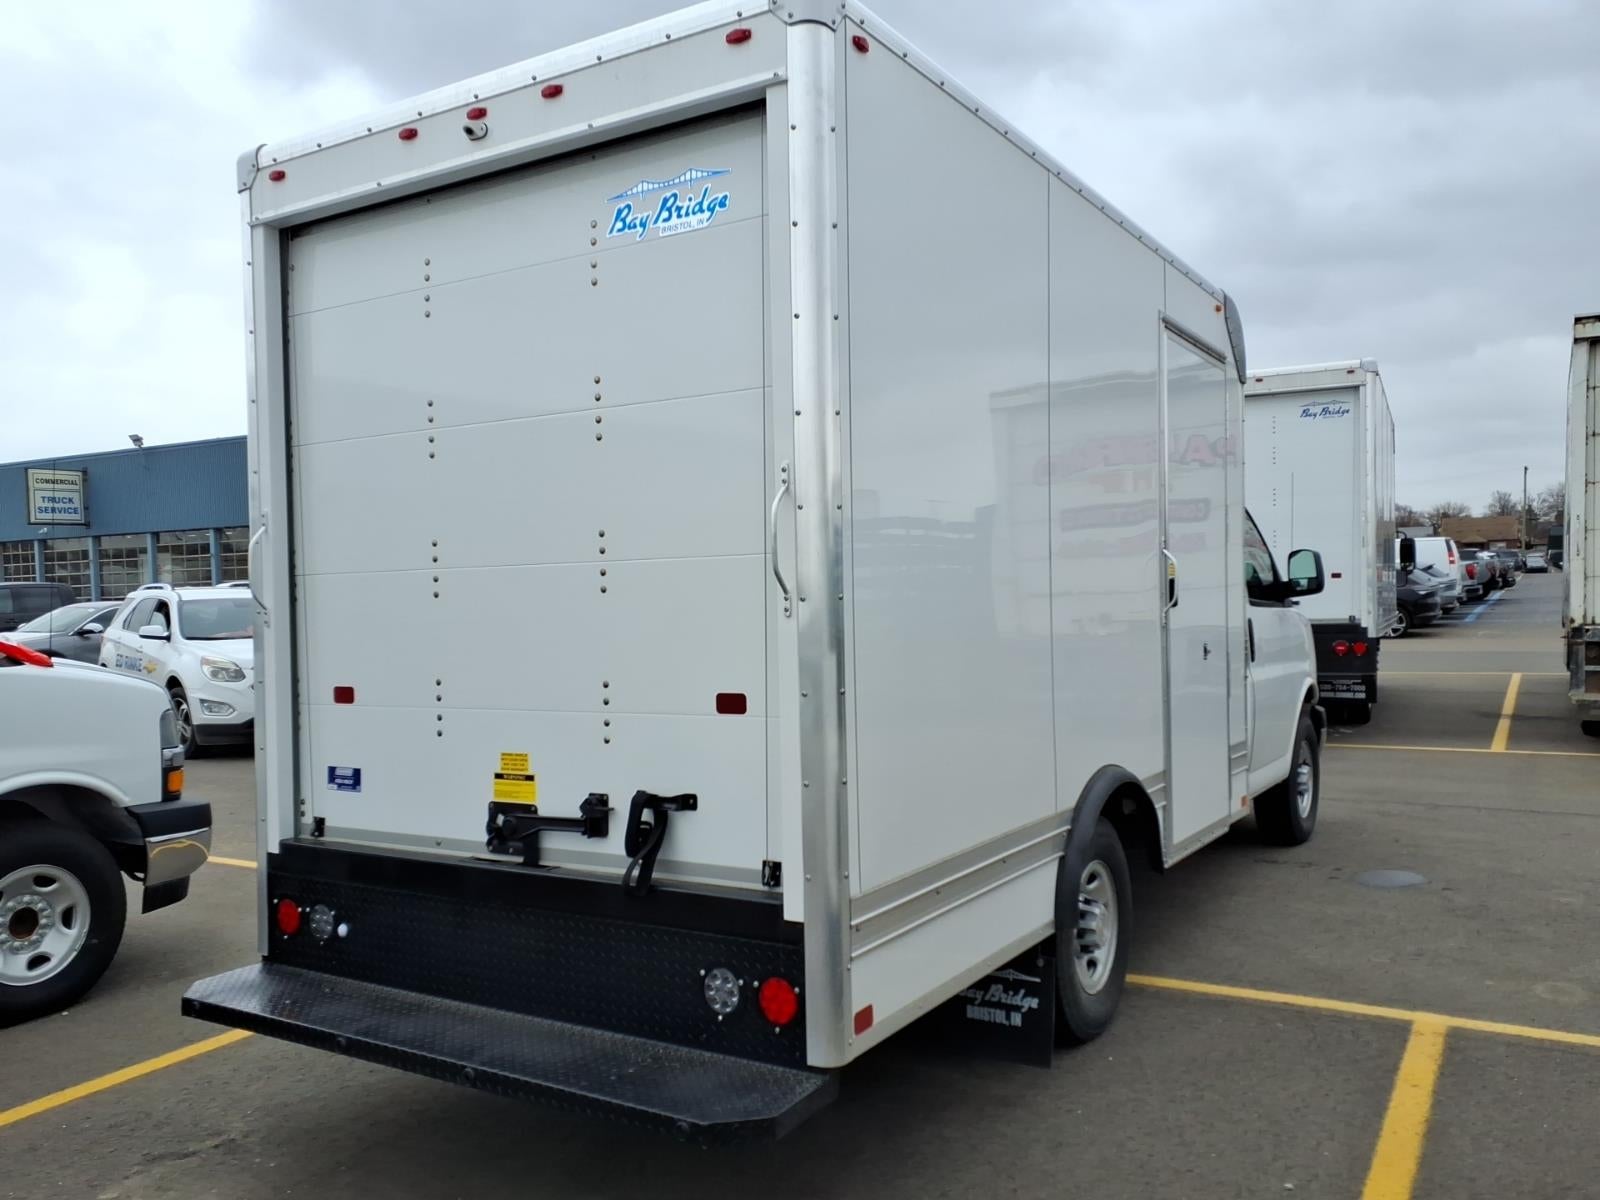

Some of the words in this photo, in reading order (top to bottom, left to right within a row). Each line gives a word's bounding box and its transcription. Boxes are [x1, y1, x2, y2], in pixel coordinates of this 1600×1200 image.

[607, 202, 651, 239] Bay
[652, 184, 729, 226] Bridge
[696, 219, 705, 228] IN
[1300, 408, 1318, 419] Bay
[1319, 406, 1350, 417] Bridge
[35, 478, 78, 486] COMMERCIAL
[40, 496, 75, 504] TRUCK
[37, 506, 80, 515] SERVICE
[985, 984, 1039, 1012] Bridge
[1011, 1011, 1022, 1028] IN
